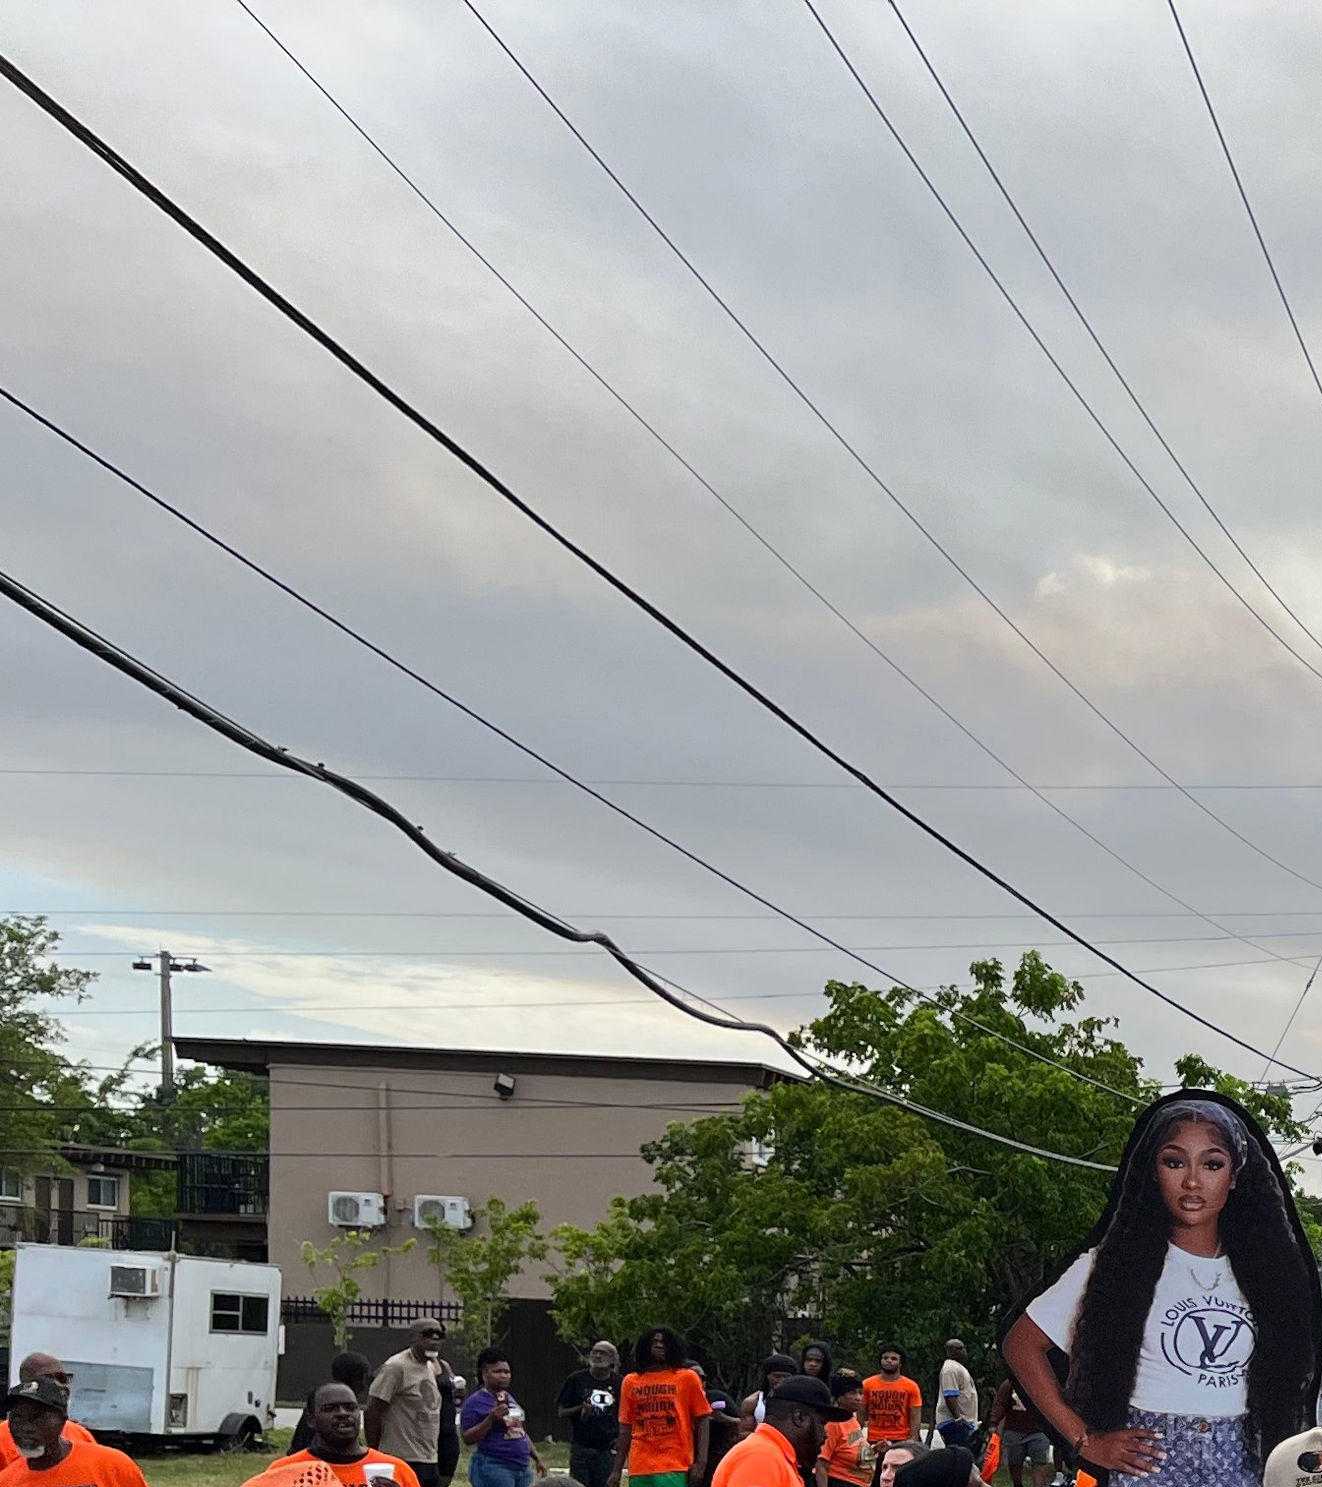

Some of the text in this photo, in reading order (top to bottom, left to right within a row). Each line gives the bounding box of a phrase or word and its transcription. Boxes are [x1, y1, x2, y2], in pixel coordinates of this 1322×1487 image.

[1161, 1295, 1257, 1327] LOUIS VUITTO
[1198, 1373, 1239, 1388] PARIS
